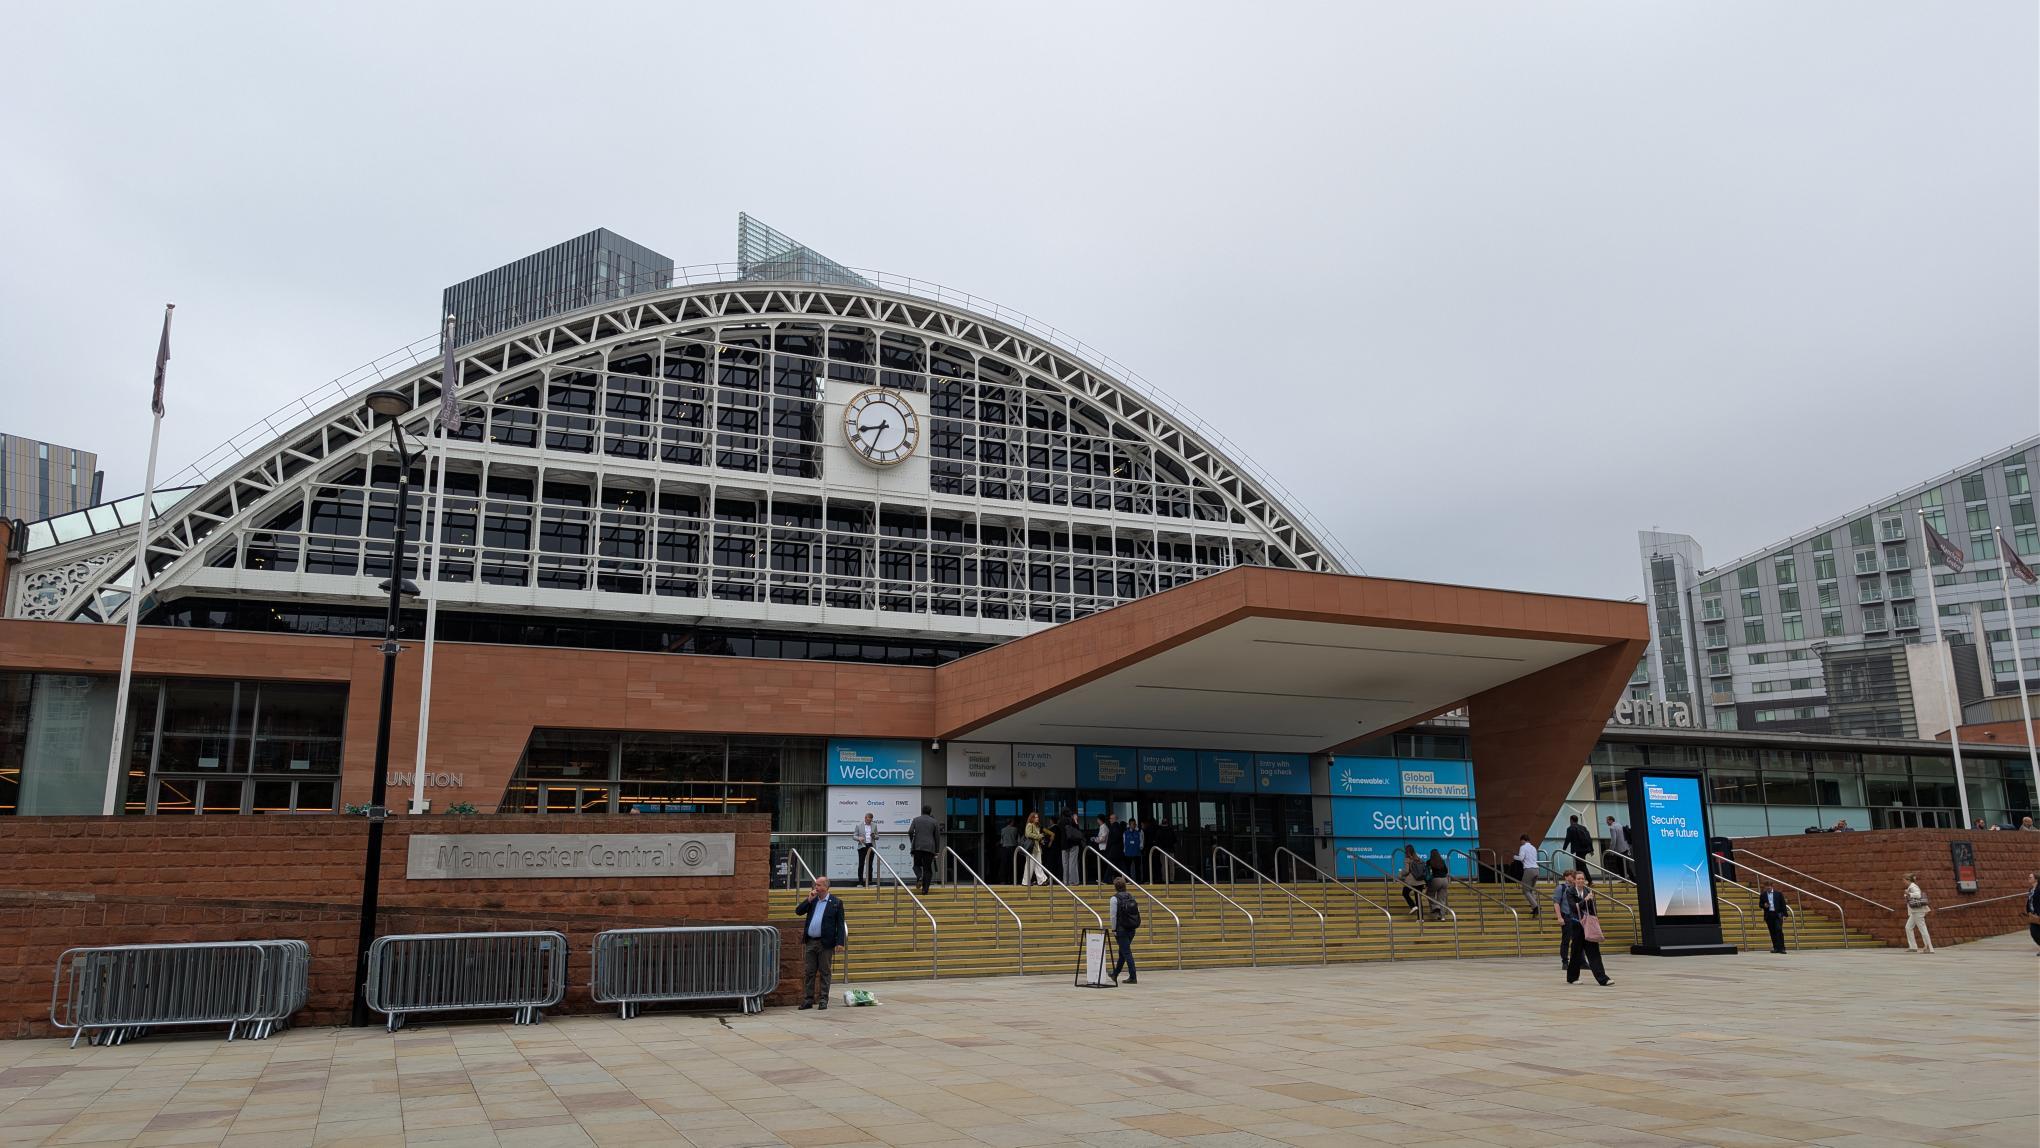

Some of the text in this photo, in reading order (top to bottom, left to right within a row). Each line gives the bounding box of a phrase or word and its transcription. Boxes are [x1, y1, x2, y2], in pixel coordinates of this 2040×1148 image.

[1607, 691, 1701, 730] entral
[1017, 751, 1035, 760] Entry
[1143, 756, 1160, 765] Entry
[1143, 764, 1157, 772] bag
[1277, 760, 1290, 768] with
[839, 764, 915, 780] Welcome
[1260, 769, 1273, 777] bag
[386, 771, 464, 788] UNTION
[1348, 776, 1390, 785] RenewableUK
[1403, 773, 1433, 783] Global
[1404, 785, 1467, 795] Offshore Wind
[1372, 811, 1455, 838] Securing
[1651, 815, 1686, 828] Securing
[1660, 827, 1699, 838] the future
[436, 842, 674, 870] Manchester Central
